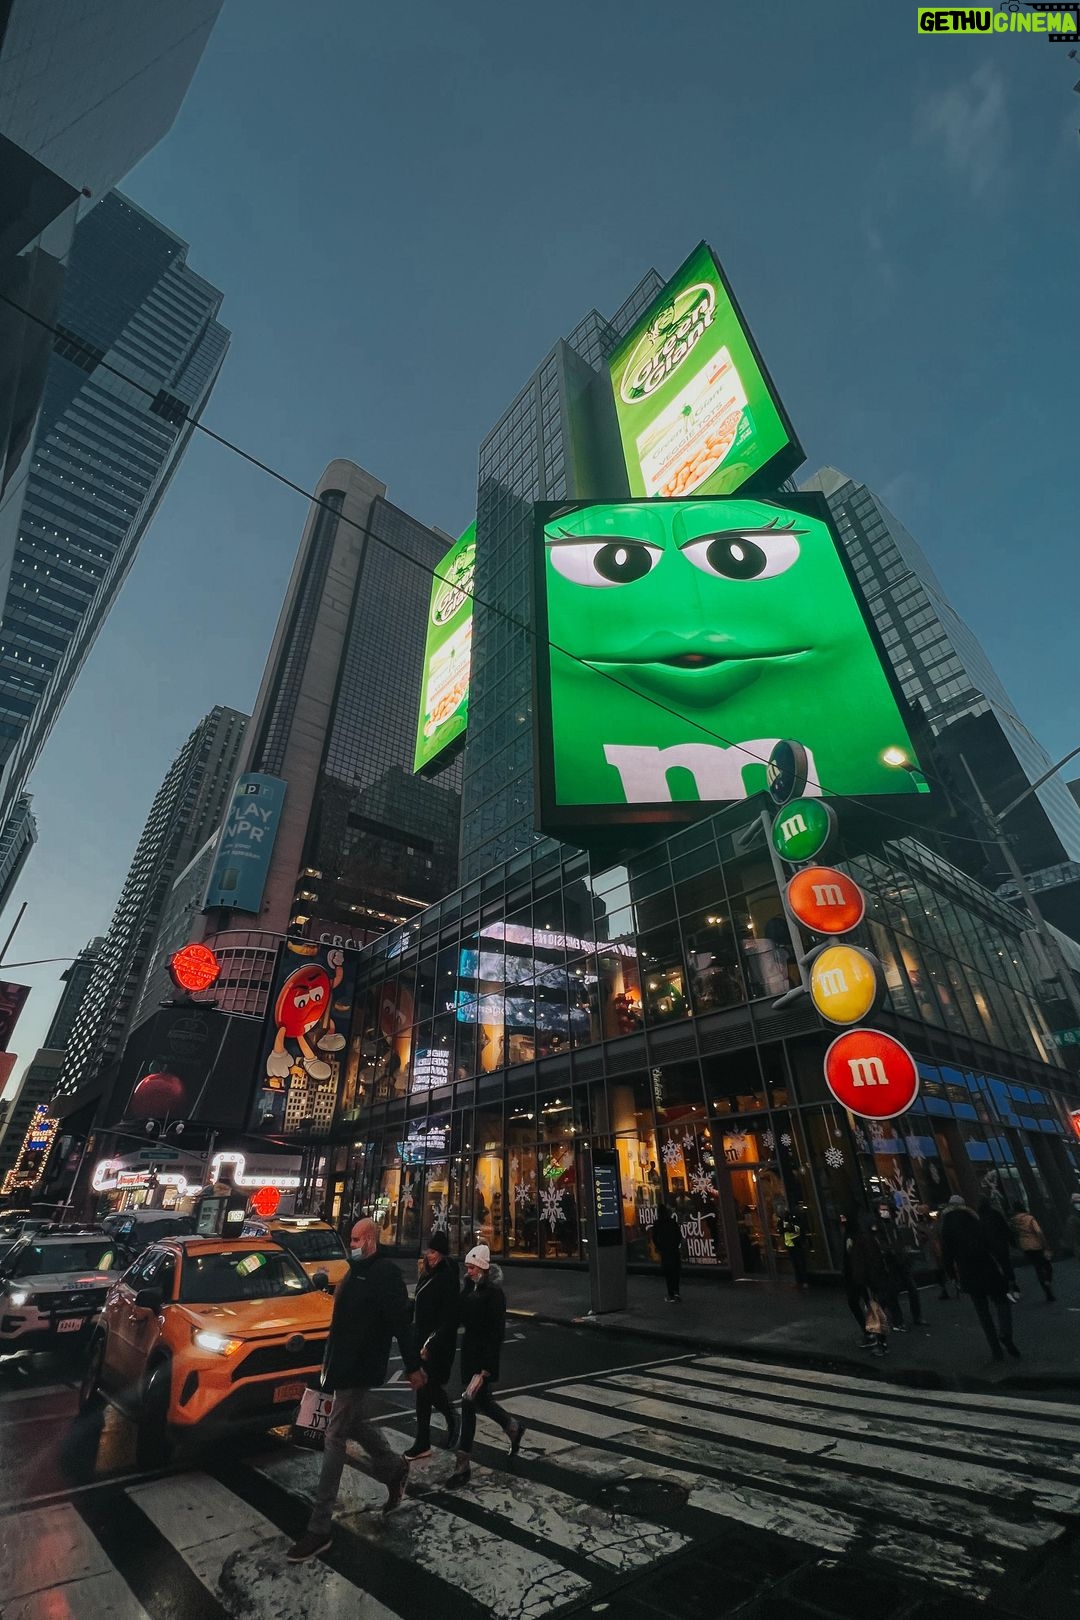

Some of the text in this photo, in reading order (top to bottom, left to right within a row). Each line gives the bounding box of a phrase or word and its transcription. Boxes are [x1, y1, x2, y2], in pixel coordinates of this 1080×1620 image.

[632, 298, 711, 389] Green
[643, 304, 718, 393] Giant
[781, 814, 808, 841] m
[811, 883, 846, 906] m
[819, 967, 849, 997] m
[847, 1056, 889, 1087] m
[638, 1208, 659, 1224] HOM
[687, 1238, 717, 1257] HOME
